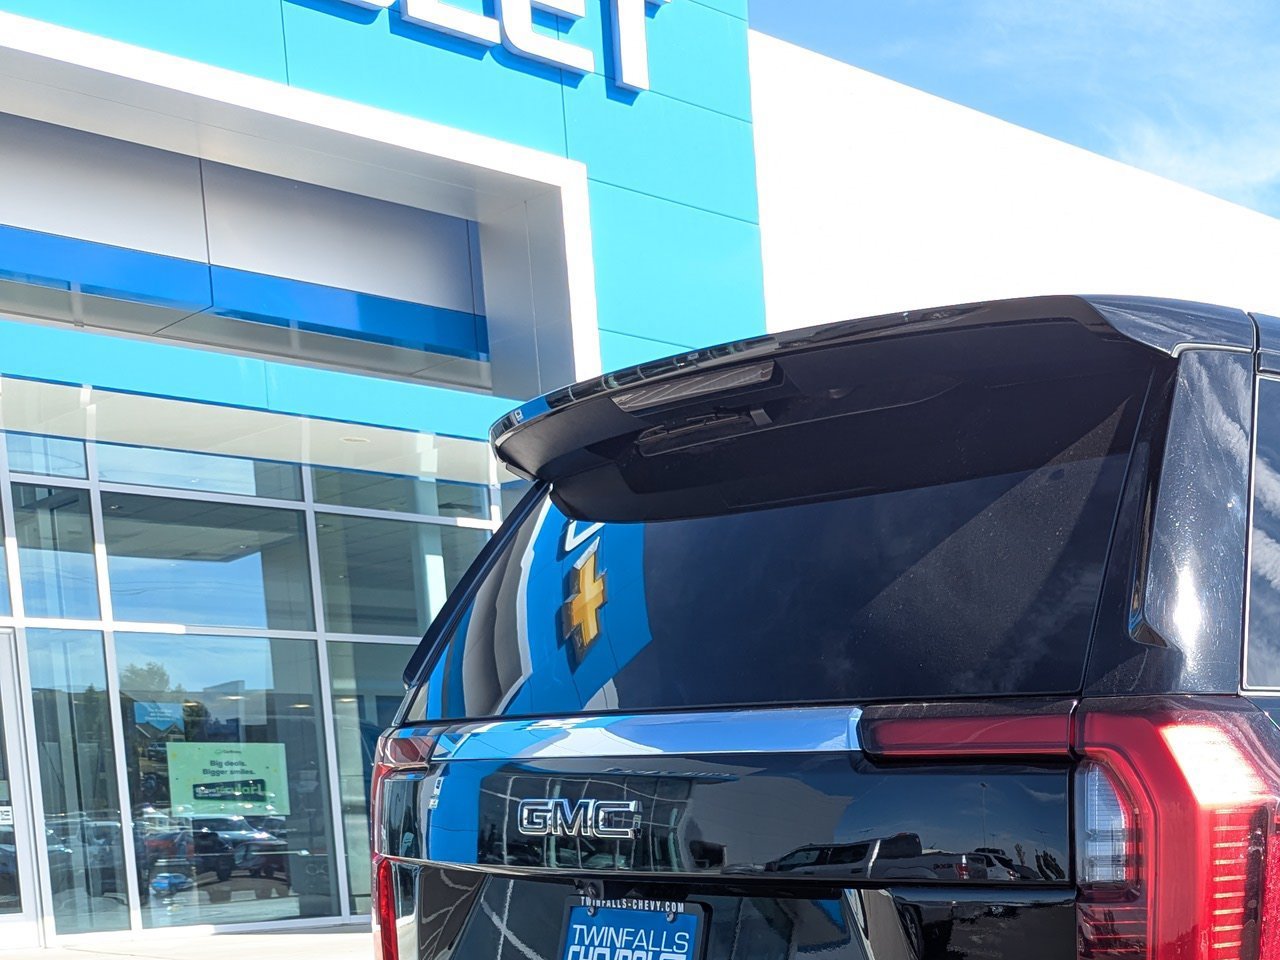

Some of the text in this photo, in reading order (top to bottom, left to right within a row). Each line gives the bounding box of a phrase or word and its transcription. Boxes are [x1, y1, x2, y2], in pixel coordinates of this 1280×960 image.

[210, 760, 223, 768] Big
[202, 769, 228, 777] Bigger
[518, 798, 641, 838] GMC
